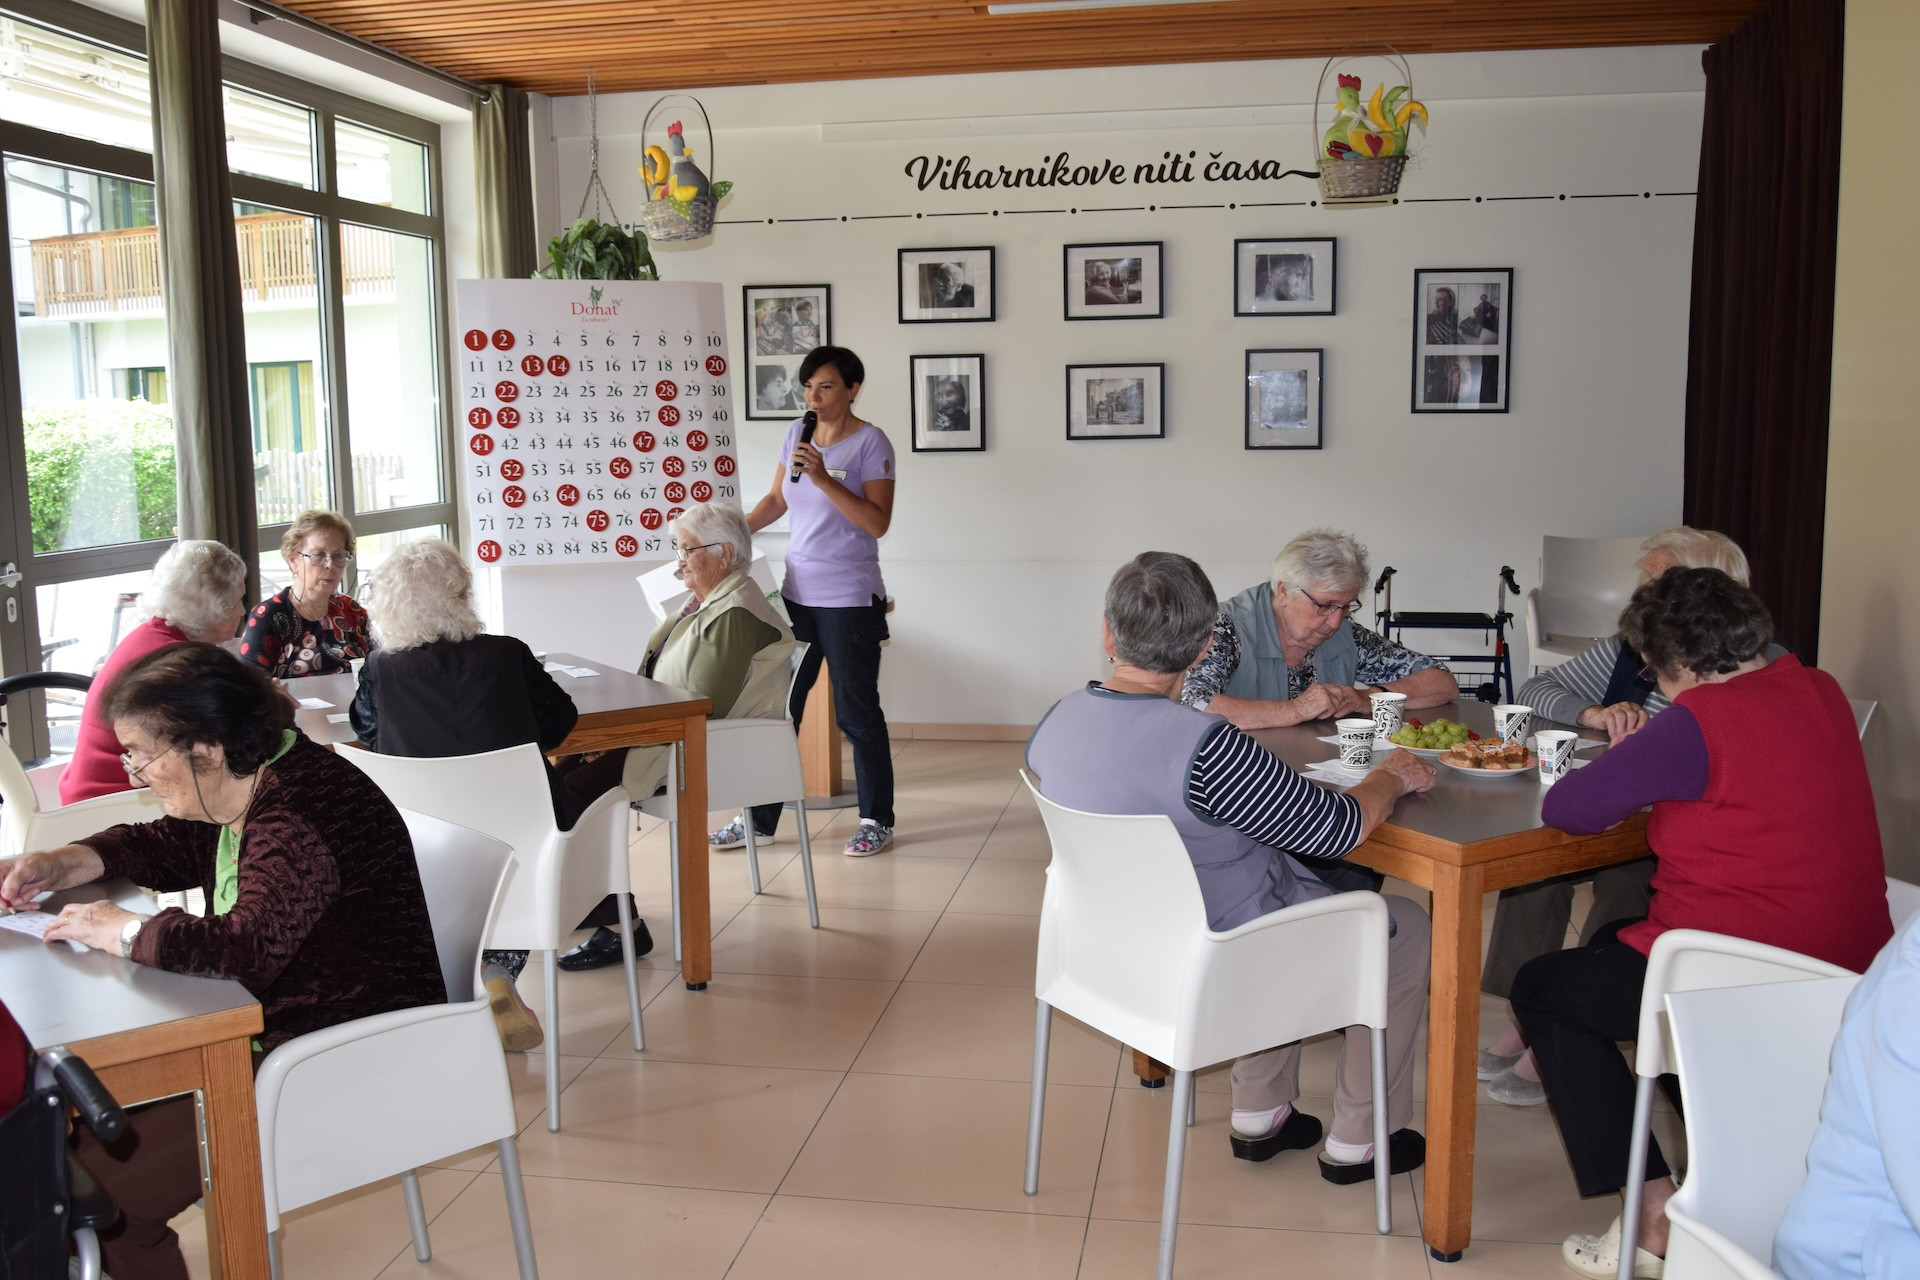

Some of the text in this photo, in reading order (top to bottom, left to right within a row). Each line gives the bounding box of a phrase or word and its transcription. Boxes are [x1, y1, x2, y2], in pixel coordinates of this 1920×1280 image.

[905, 151, 1293, 191] Viharnikove niti časa
[571, 302, 618, 316] Donat
[473, 334, 721, 347] 1 2 3 4 5 6 7 8 9 10
[470, 360, 724, 372] 11 12 13 14 15 16 17 18 19 20
[471, 384, 726, 398] 21 22 23 24 25 26 27 28 29 30
[471, 410, 728, 424] 31 32 33 34 35 36 37 38 39 40
[472, 435, 730, 451] 41 42 43 44 45 46 47 48 49 50
[476, 460, 733, 478] 51 52 53 54 55 56 57 58 59 60
[476, 486, 735, 504] 61 62 63 64 65 66 67 68 69 70
[479, 518, 494, 531] 71
[506, 517, 524, 530] 72
[534, 516, 551, 529] 73
[561, 516, 579, 528] 74
[588, 514, 606, 527] 75
[616, 514, 633, 526] 76
[642, 513, 659, 525] 77
[479, 545, 496, 558] 81
[508, 543, 526, 556] 82
[536, 542, 553, 556] 83
[563, 542, 581, 554] 84
[591, 541, 608, 554] 85
[618, 540, 636, 553] 86
[644, 539, 661, 552] 87
